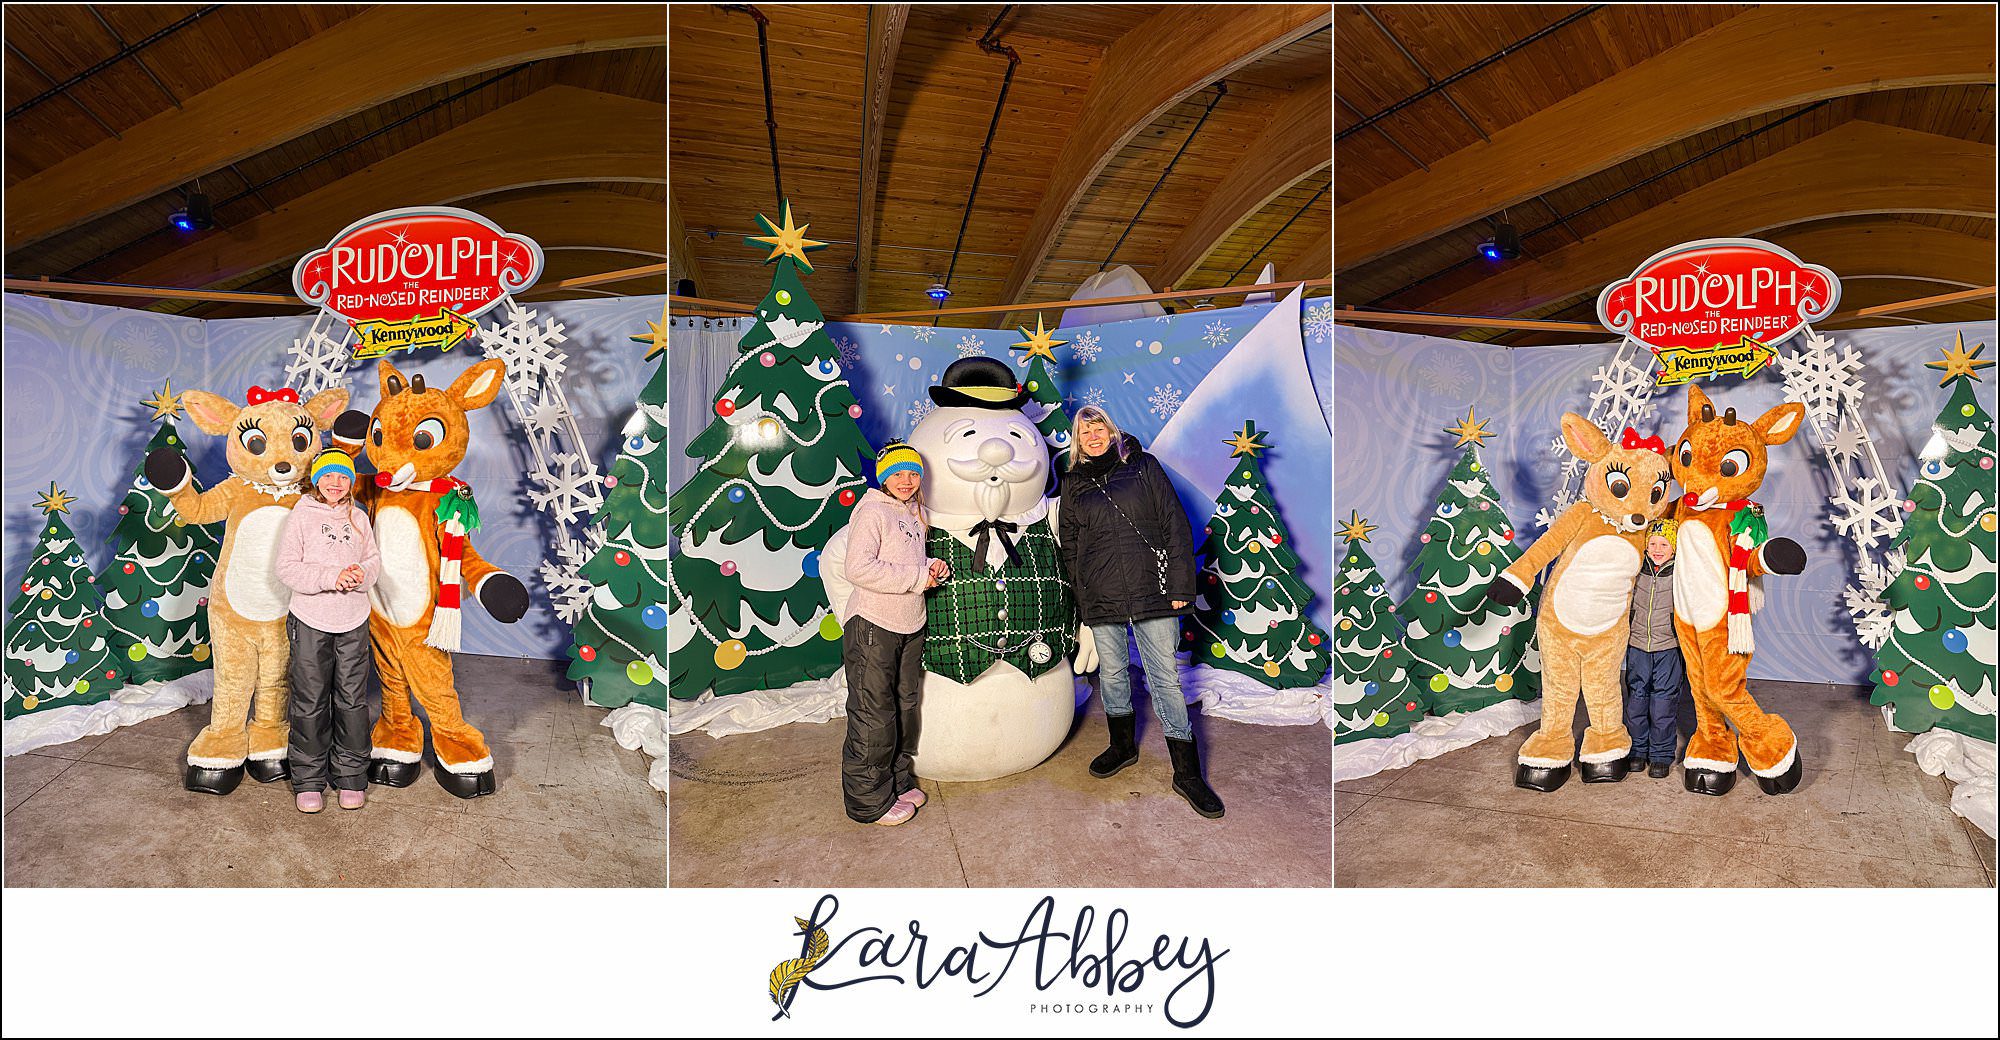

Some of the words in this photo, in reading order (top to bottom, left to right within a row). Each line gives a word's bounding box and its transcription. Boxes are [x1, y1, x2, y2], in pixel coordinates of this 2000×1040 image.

[332, 236, 498, 289] RUDOLPH
[403, 281, 419, 289] THE
[1635, 267, 1796, 318] RUDOLPH
[337, 290, 416, 311] RED-NOSED
[1705, 310, 1721, 318] THE
[371, 321, 454, 345] Kennywood
[1640, 320, 1717, 339] RED-NOSED
[1674, 350, 1754, 372] Kennywood
[1652, 523, 1663, 532] M
